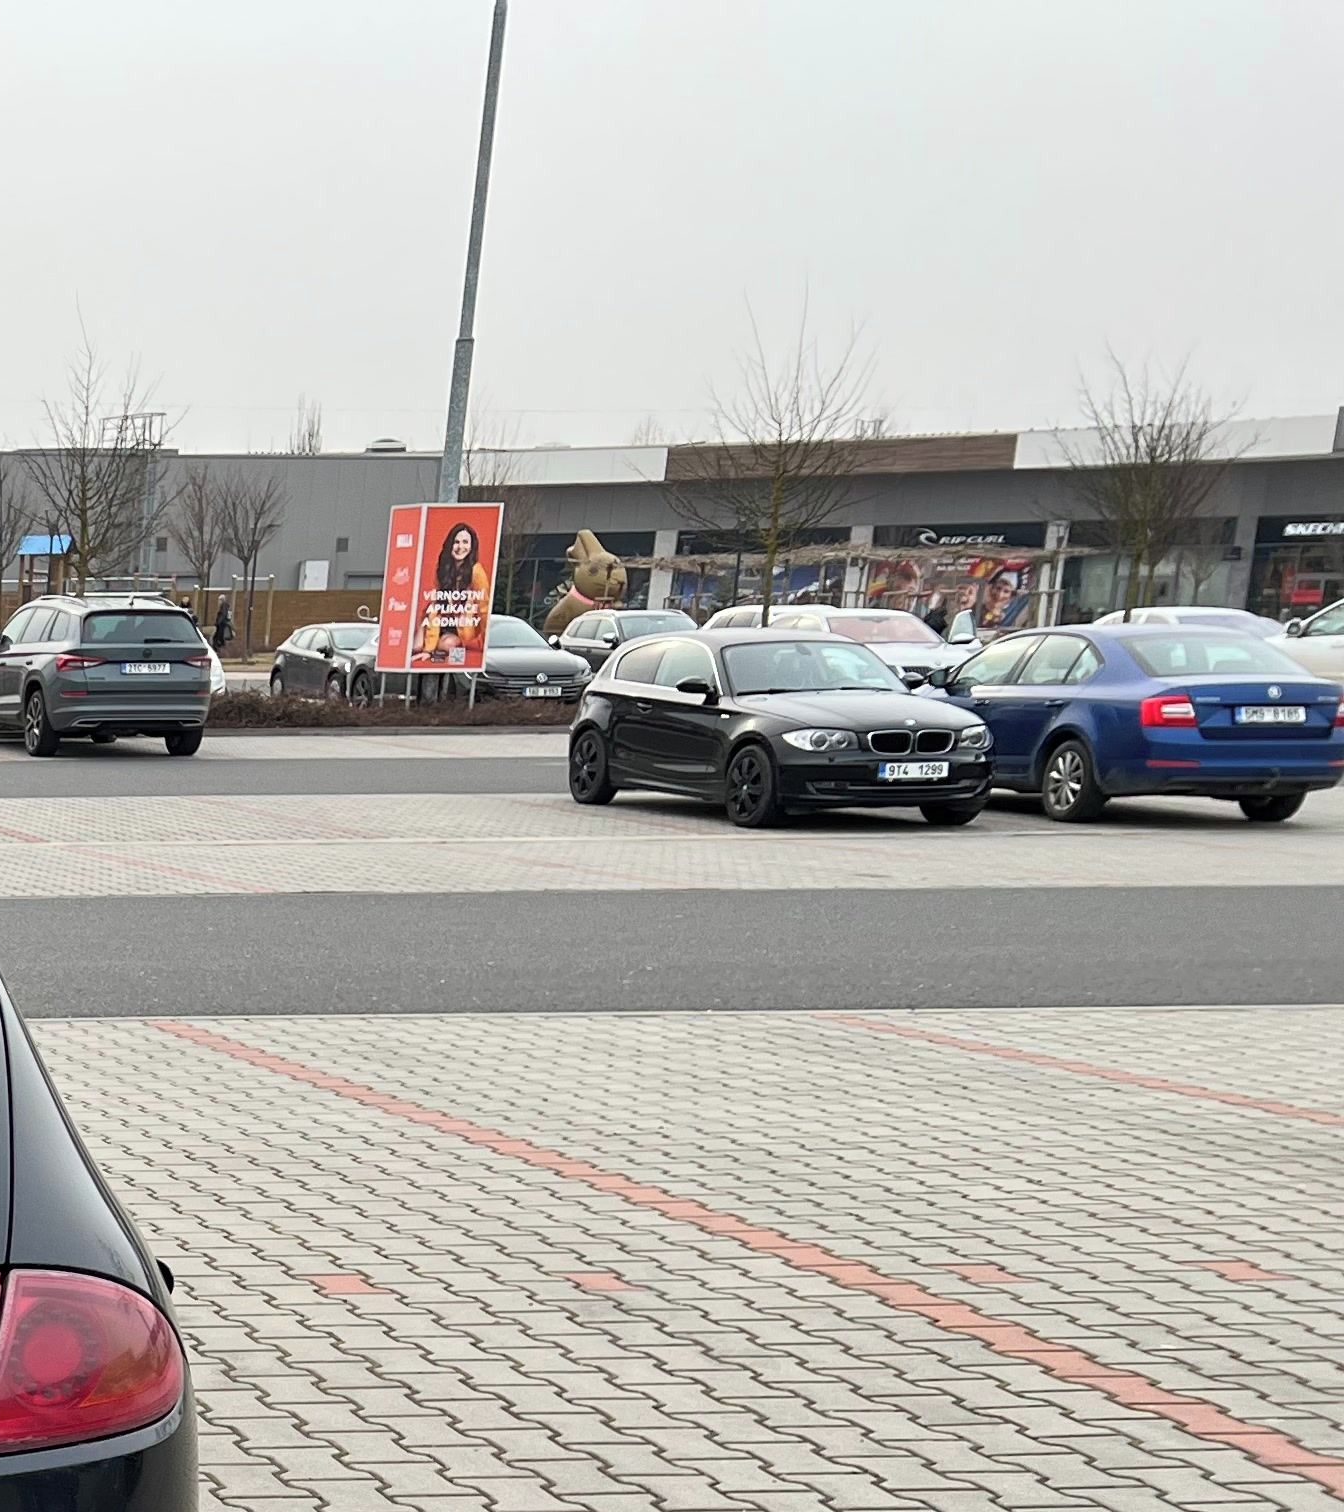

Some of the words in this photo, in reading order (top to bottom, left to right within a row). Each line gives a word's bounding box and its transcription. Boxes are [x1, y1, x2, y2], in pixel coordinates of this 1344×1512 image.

[939, 535, 965, 544] RIP
[967, 535, 1006, 544] CURL
[423, 588, 485, 601] VĚRNOSTNÍ
[422, 617, 430, 627] A
[889, 765, 909, 776] 9T4
[919, 764, 944, 776] 1299
